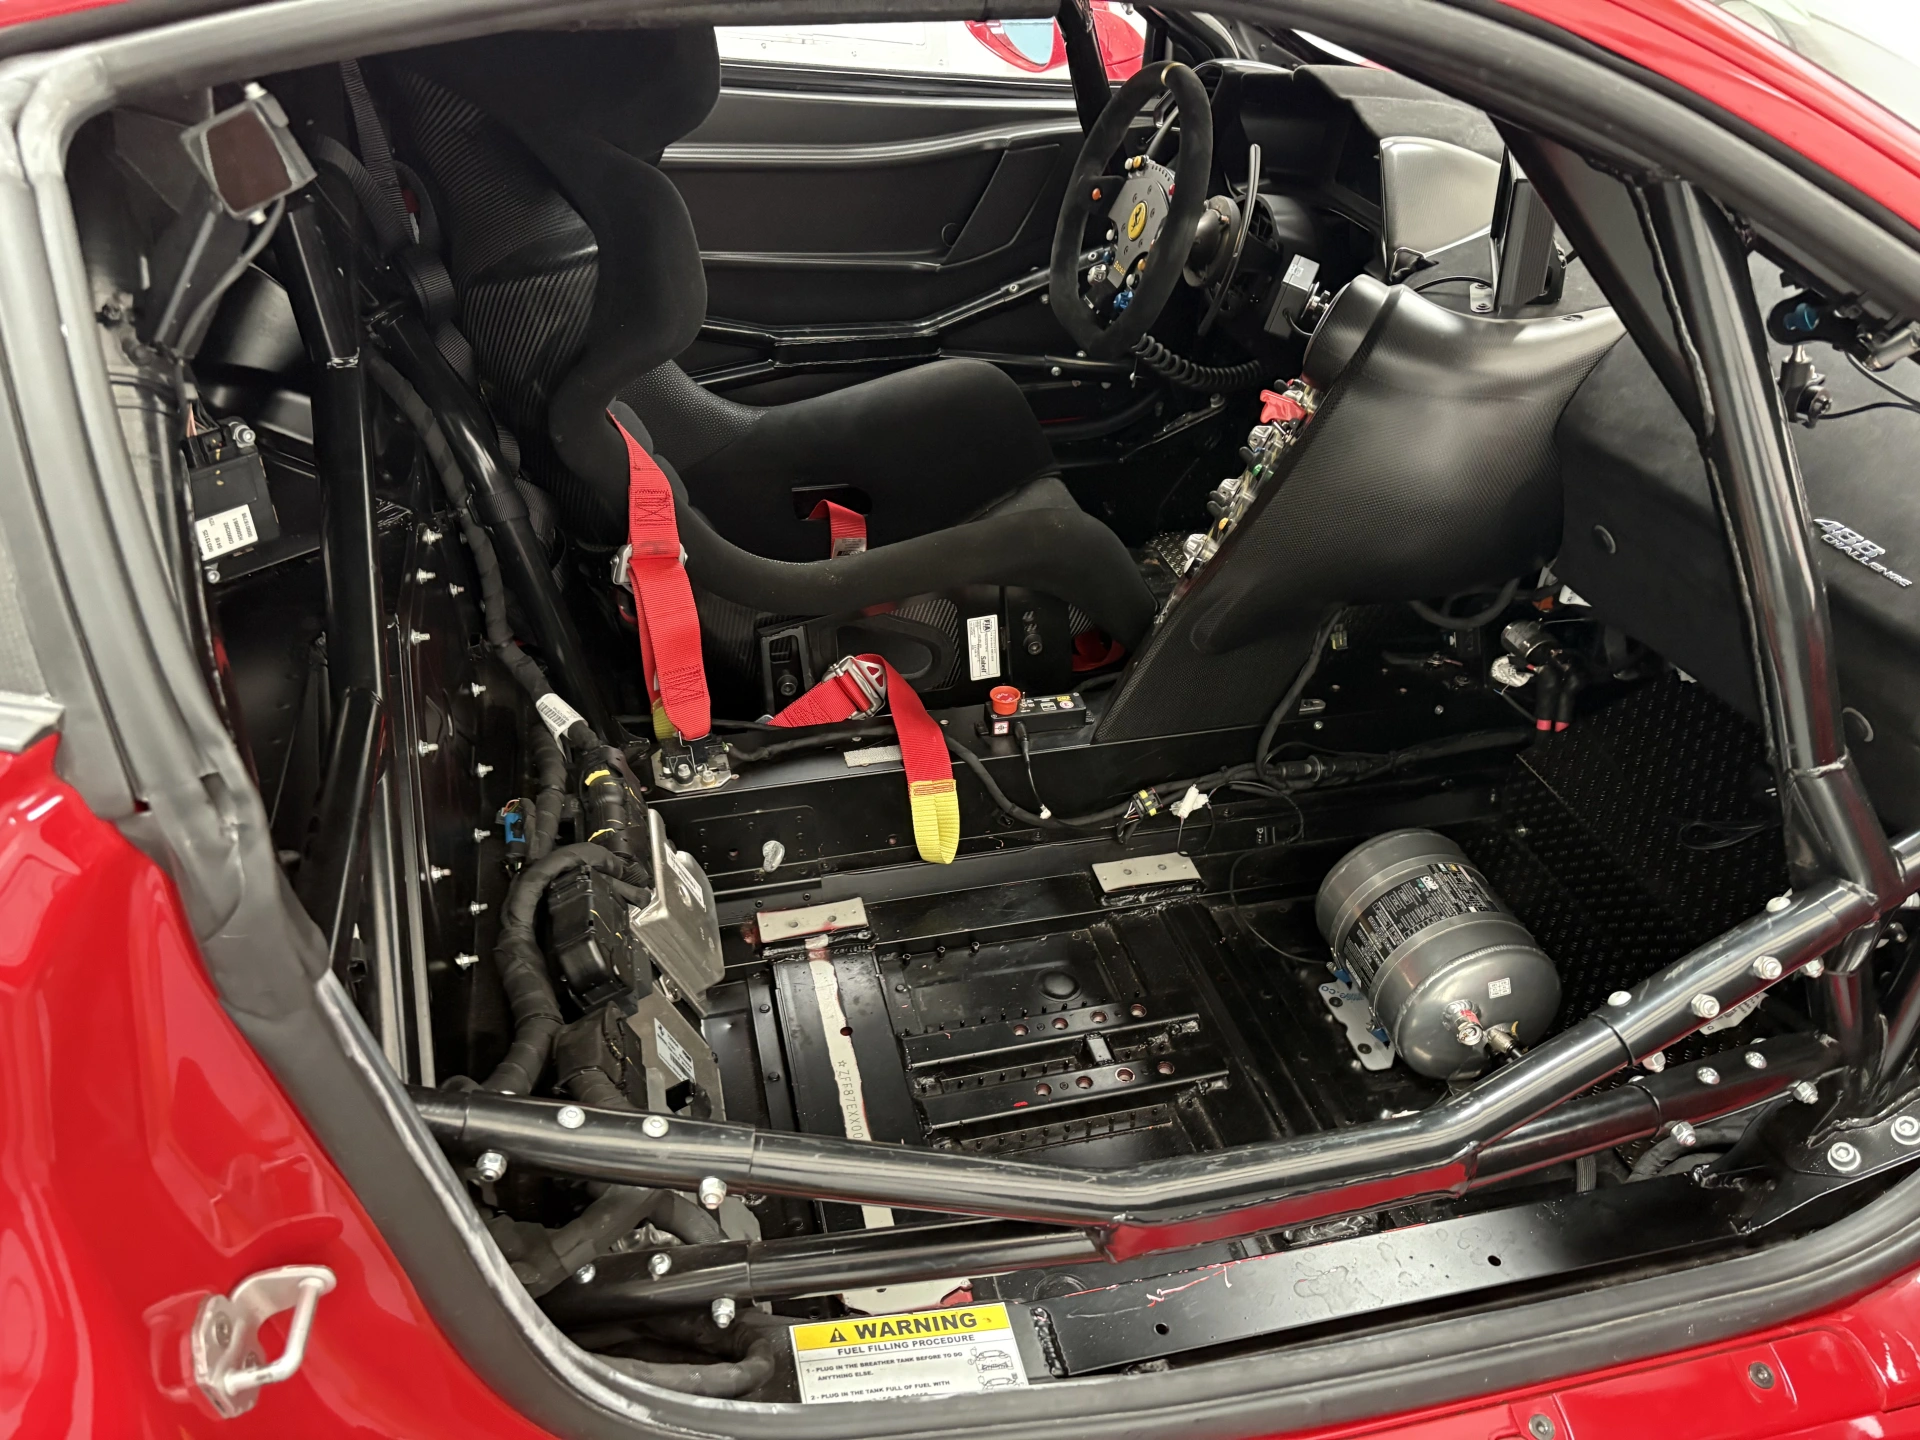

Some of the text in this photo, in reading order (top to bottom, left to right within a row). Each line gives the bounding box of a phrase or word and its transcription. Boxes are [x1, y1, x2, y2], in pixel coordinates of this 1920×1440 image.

[1813, 518, 1886, 558] 488
[1820, 533, 1912, 587] CHALLENGE
[854, 1312, 978, 1340] WARNING
[837, 1334, 976, 1356] FUEL FILLING PROCEDURE
[816, 1365, 834, 1373] PLUG
[860, 1359, 895, 1367] BREATHER
[817, 1372, 853, 1381] ANYTHING
